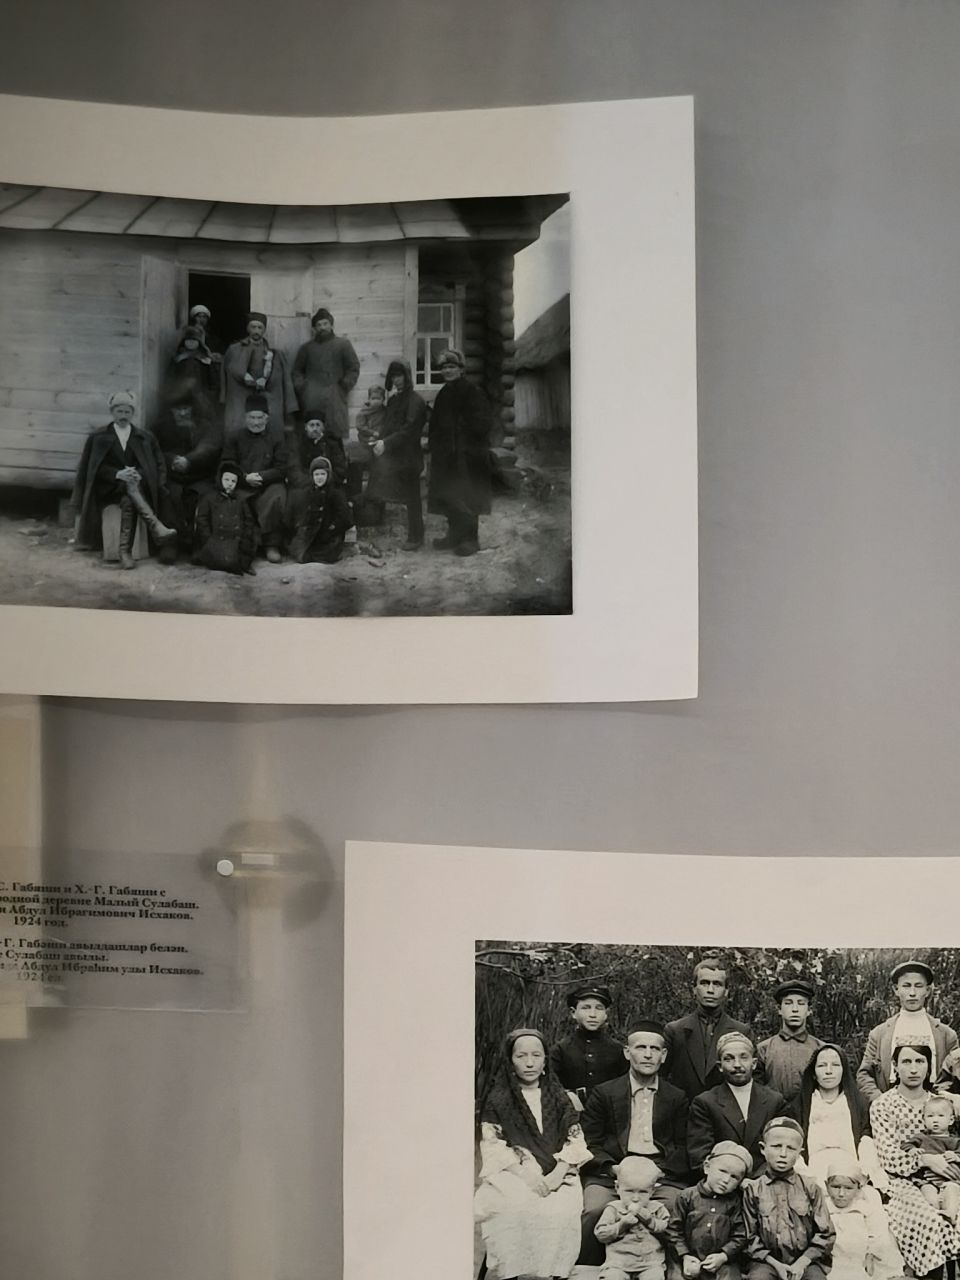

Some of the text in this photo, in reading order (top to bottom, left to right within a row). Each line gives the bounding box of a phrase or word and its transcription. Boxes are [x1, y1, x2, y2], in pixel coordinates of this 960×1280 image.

[0, 894, 200, 910] одной деревне Малый Сулабаш.
[9, 904, 46, 917] Абдул
[49, 906, 136, 918] Ибрагимович
[139, 909, 194, 920] Исхаков.
[14, 916, 41, 926] 1924
[5, 949, 61, 962] Сулабаш
[20, 961, 58, 973] Абдул
[149, 965, 204, 976] Исхаков.
